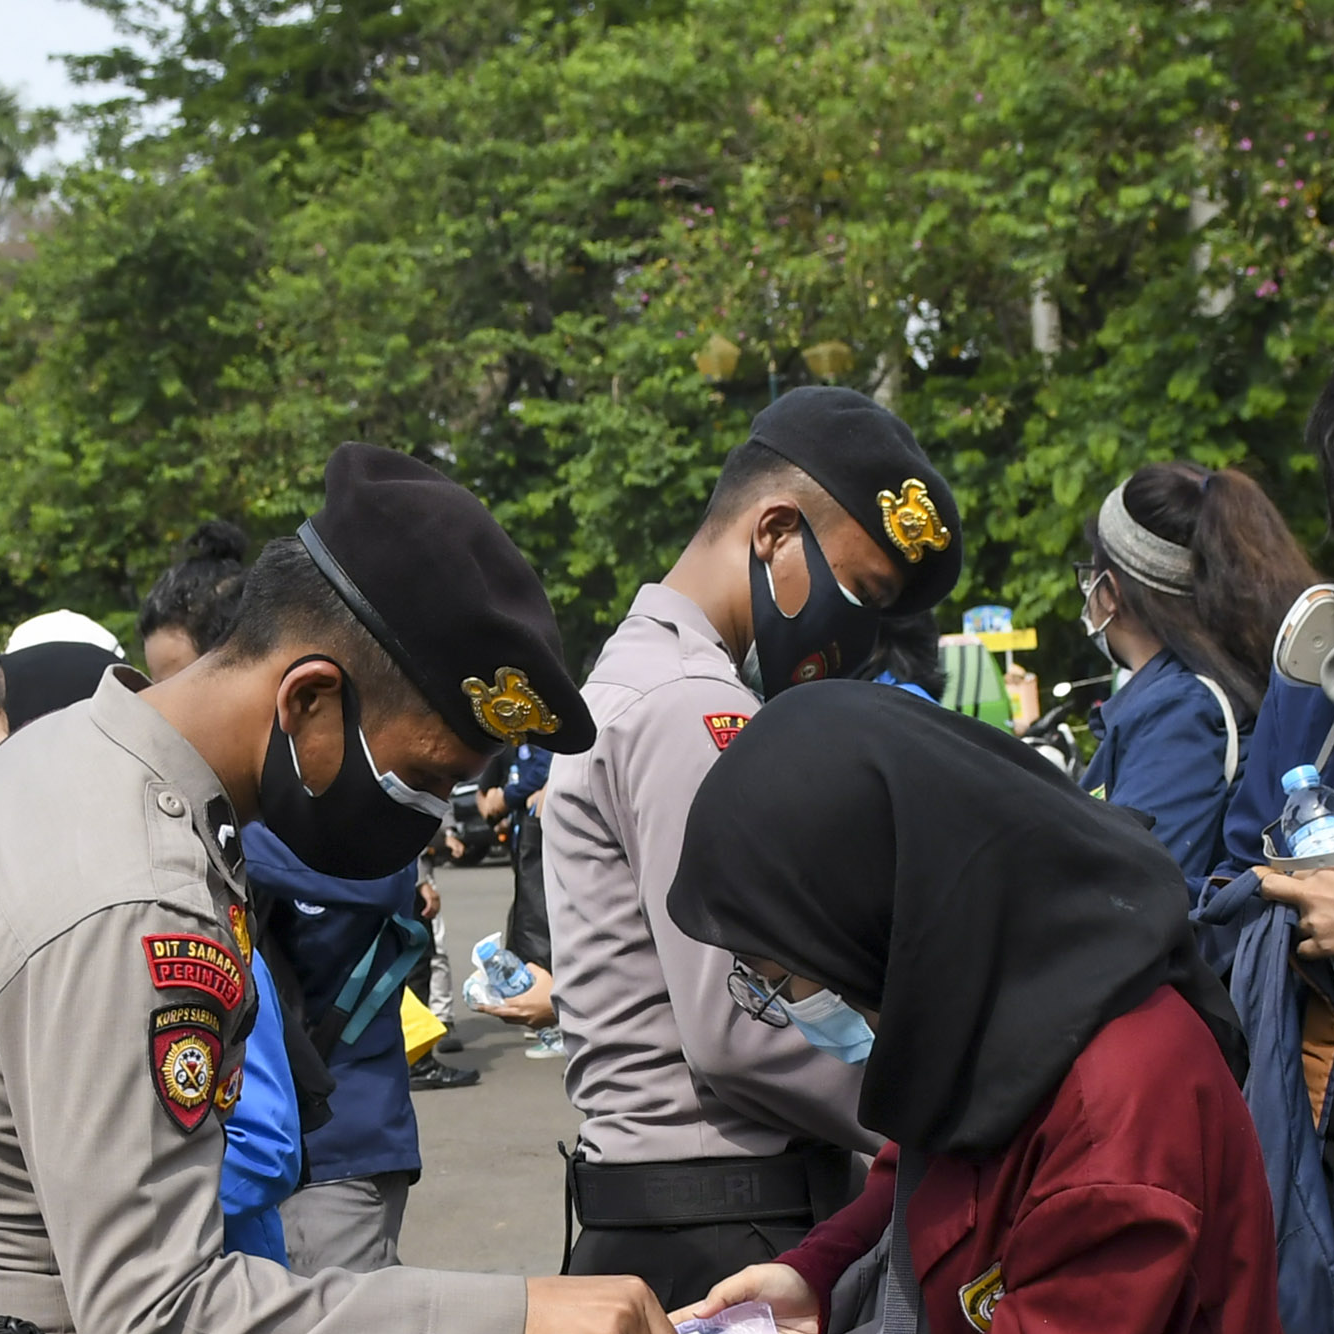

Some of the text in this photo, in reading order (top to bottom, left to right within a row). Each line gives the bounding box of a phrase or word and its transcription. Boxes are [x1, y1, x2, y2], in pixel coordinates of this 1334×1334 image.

[711, 716, 731, 728] DIT
[154, 940, 241, 985] DIT SAMAPTA
[160, 963, 238, 1003] PERINTIS
[155, 1007, 190, 1029] KORPS
